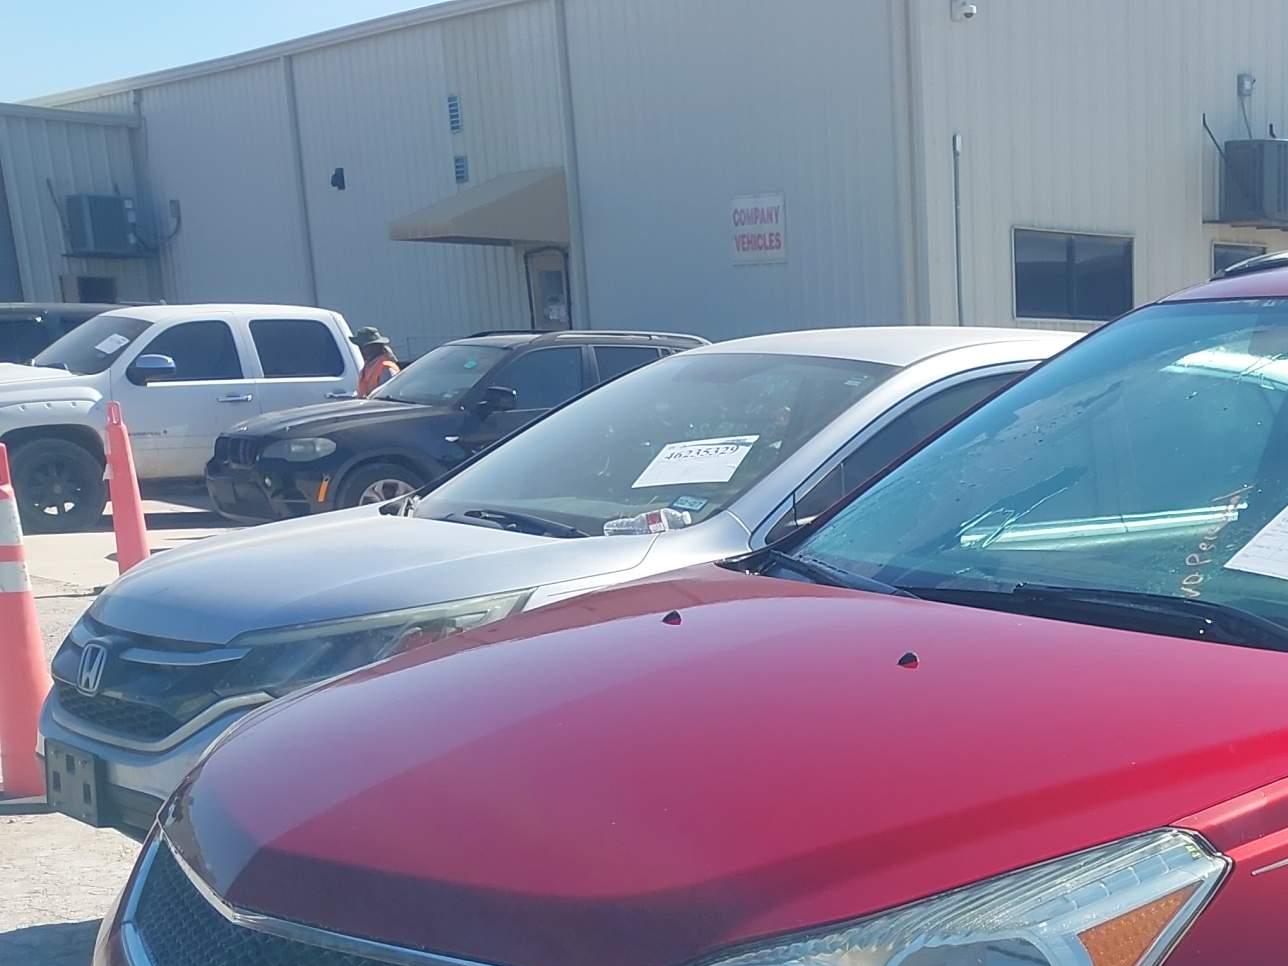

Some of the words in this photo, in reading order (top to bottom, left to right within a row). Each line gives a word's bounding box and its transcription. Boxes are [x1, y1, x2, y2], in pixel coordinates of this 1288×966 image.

[733, 205, 780, 226] COMPANY
[734, 232, 782, 252] VEHICLES
[664, 445, 740, 460] 46235329
